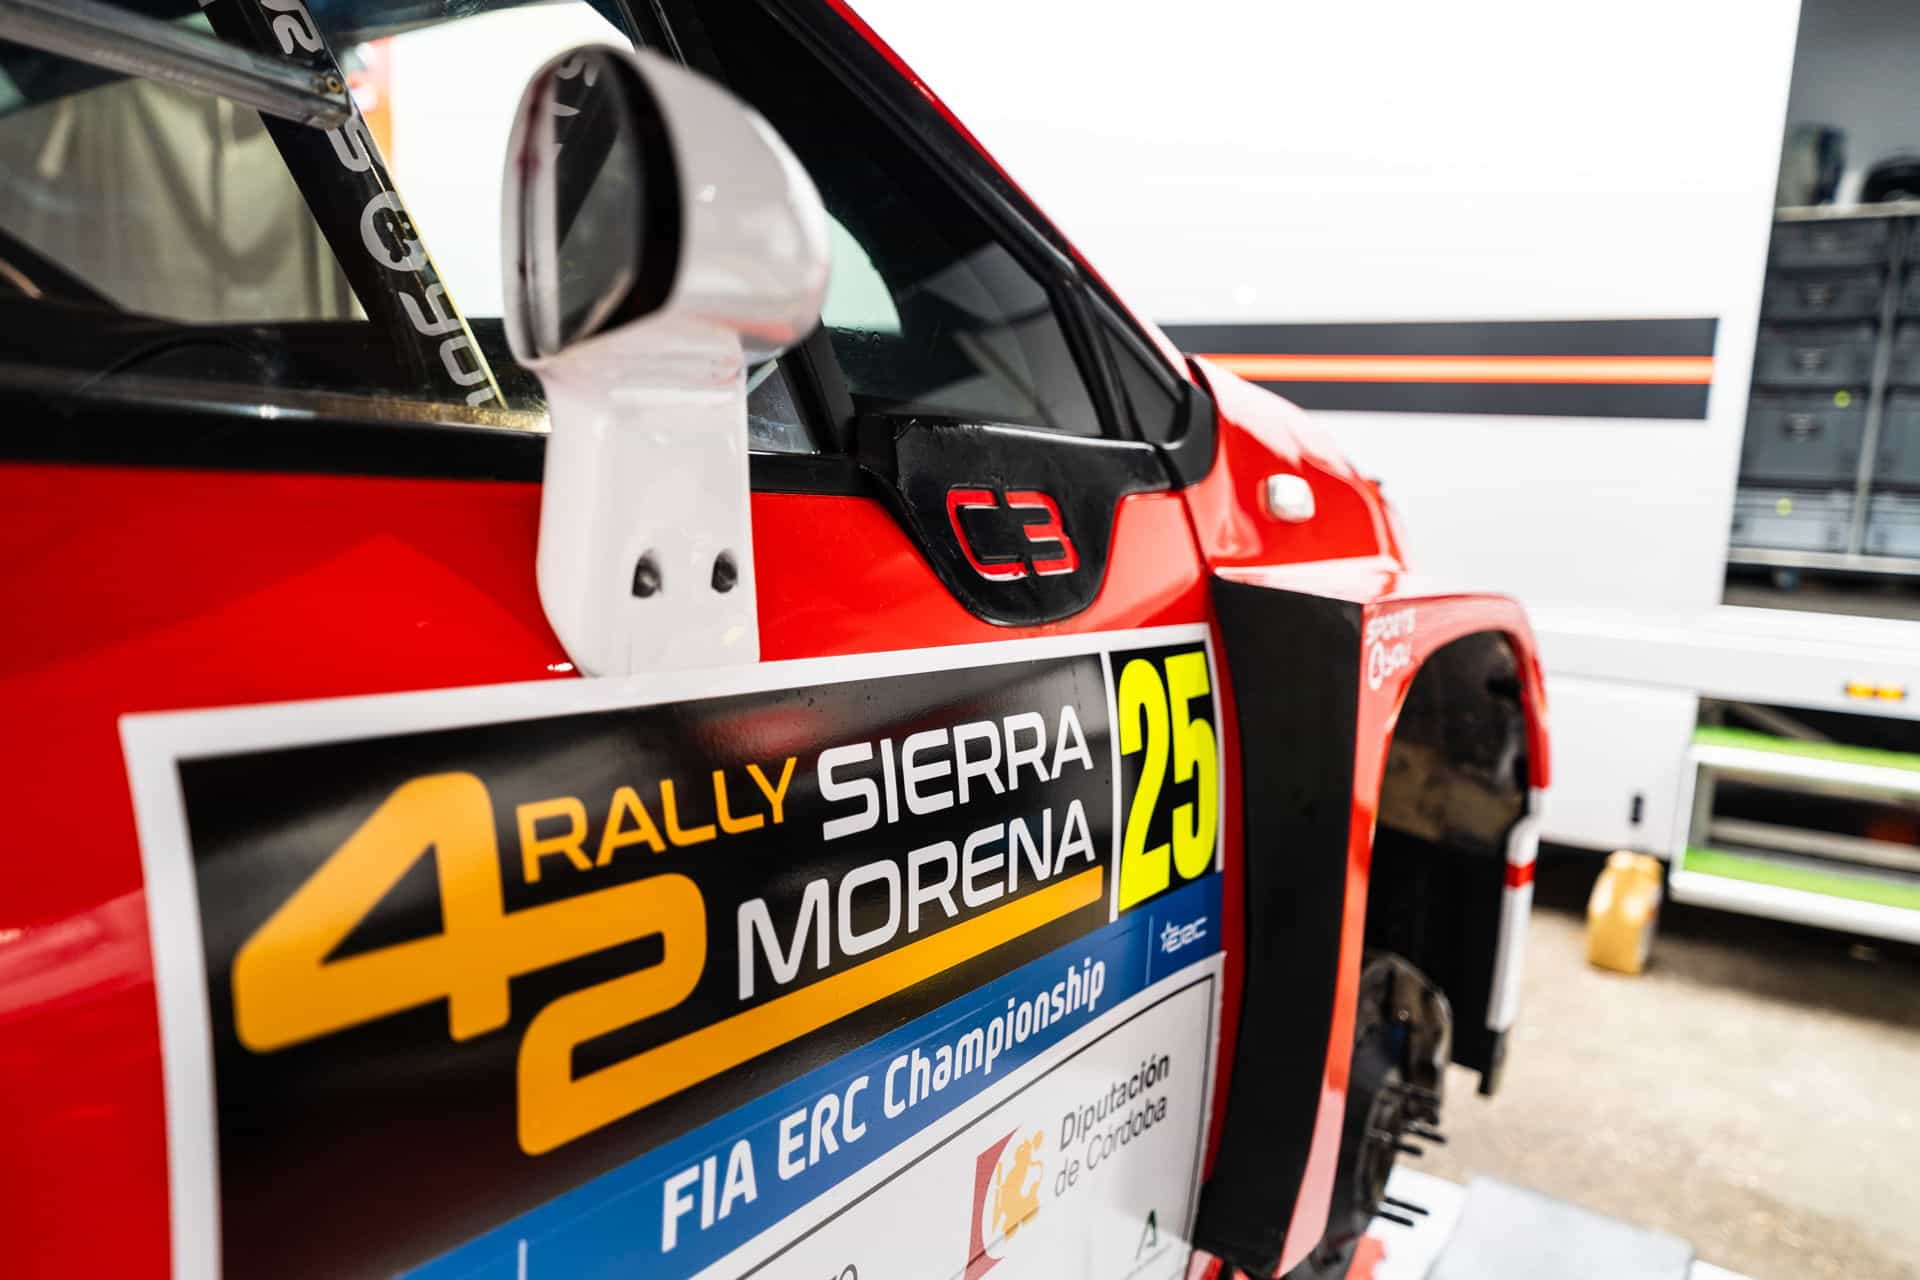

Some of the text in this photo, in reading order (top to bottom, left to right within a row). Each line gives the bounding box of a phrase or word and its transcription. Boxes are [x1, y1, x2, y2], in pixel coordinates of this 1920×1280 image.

[945, 489, 1081, 582] C3
[515, 704, 1094, 884] RALLY SIERRA
[1118, 651, 1218, 912] 25
[232, 771, 707, 1157] 42
[737, 800, 1096, 1001] MORENA
[661, 957, 1106, 1254] FIA ERC Championship
[1054, 1095, 1168, 1198] de Córdoba
[1059, 1053, 1170, 1152] Diputación
